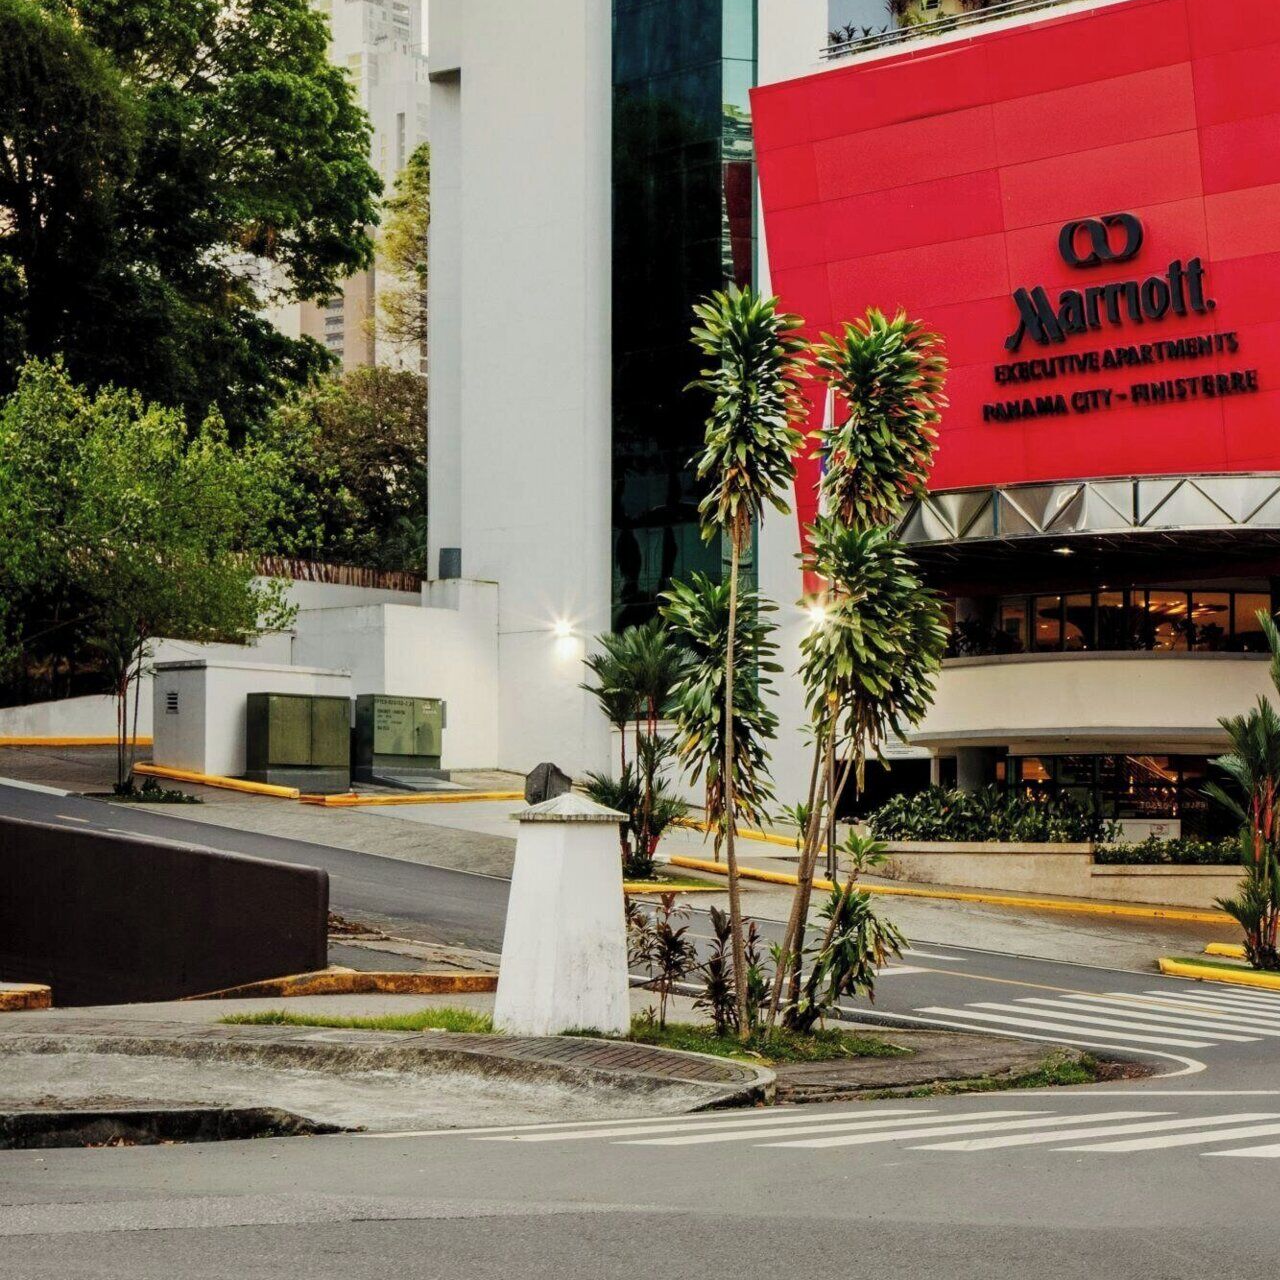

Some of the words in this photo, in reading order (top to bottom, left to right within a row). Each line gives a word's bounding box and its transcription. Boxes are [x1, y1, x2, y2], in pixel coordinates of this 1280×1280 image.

[994, 353, 1102, 387] EXECUTIVE
[1102, 332, 1239, 371] APARTMENTS
[983, 394, 1069, 424] PANAMA
[1071, 389, 1113, 415] CITY
[1130, 370, 1259, 405] FINISTERRE
